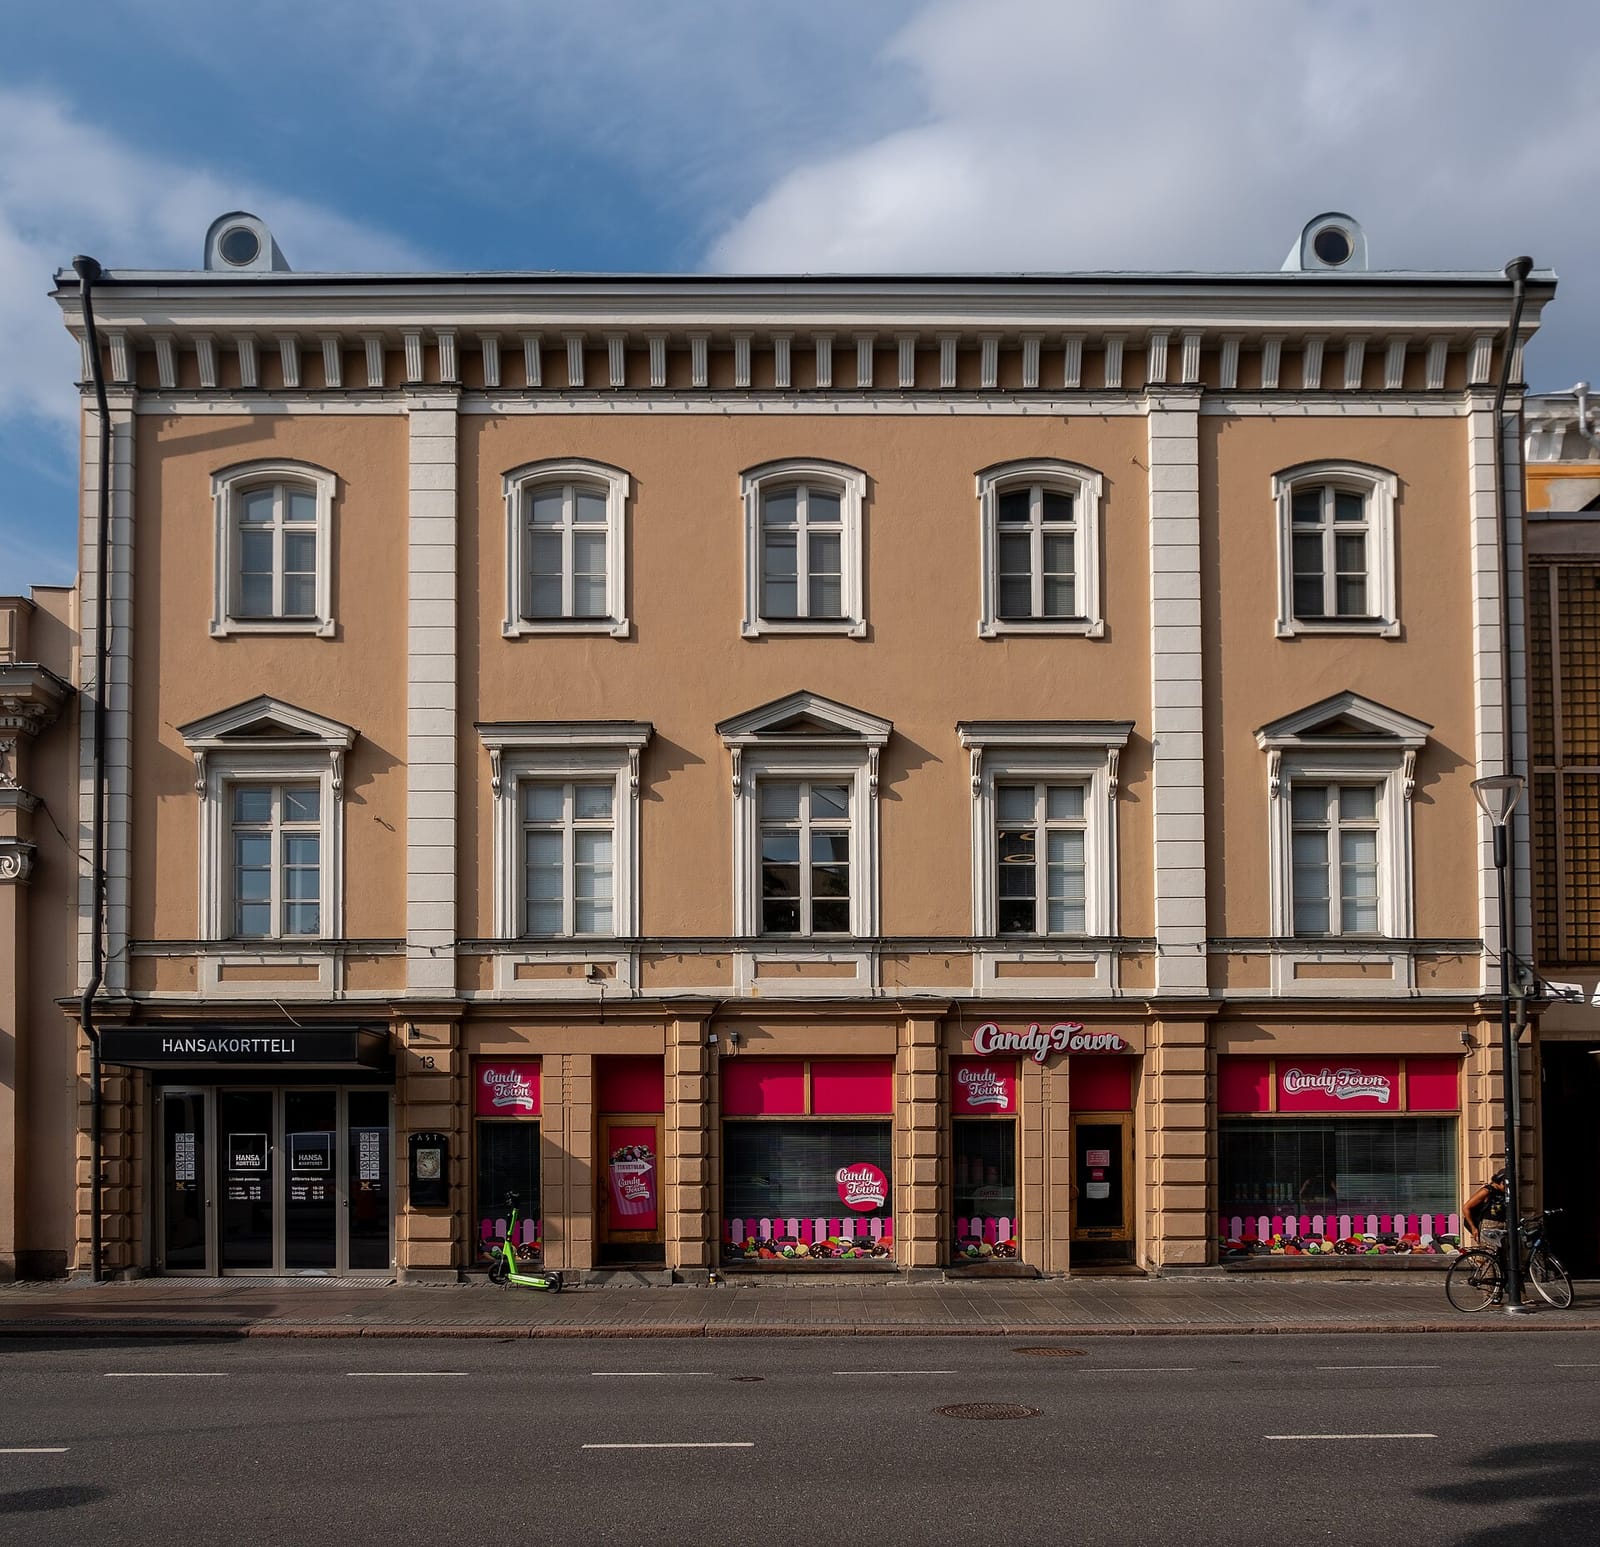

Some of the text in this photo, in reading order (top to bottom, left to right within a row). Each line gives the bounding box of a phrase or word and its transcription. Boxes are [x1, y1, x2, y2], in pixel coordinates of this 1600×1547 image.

[162, 1039, 295, 1052] HANSAKORTTELI
[974, 1023, 1123, 1062] Candy Town
[419, 1056, 435, 1069] 13
[483, 1069, 530, 1088] Candy
[958, 1068, 1004, 1087] Candy
[1284, 1069, 1386, 1094] Candy Town
[494, 1083, 530, 1097] Town
[969, 1082, 1004, 1095] Town
[618, 1176, 646, 1188] Candy
[836, 1168, 881, 1186] Candy
[847, 1182, 881, 1194] Town
